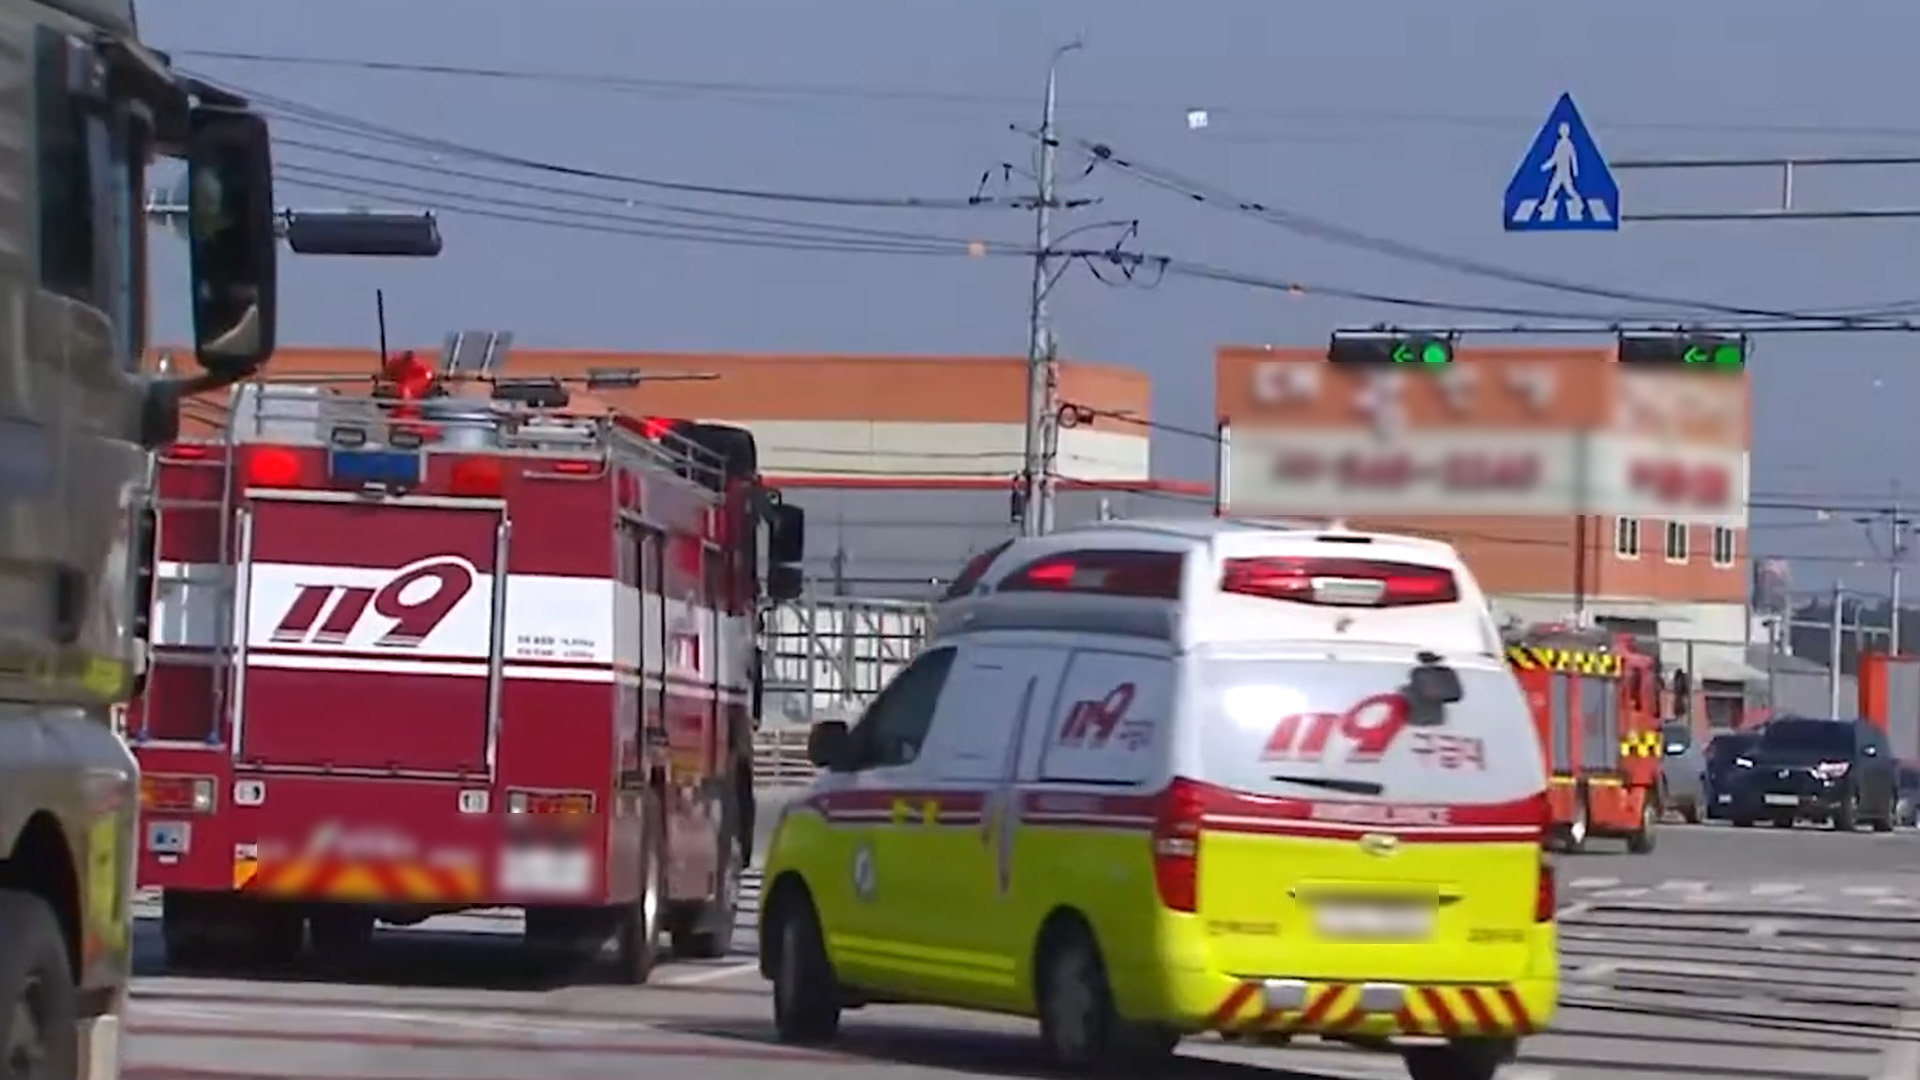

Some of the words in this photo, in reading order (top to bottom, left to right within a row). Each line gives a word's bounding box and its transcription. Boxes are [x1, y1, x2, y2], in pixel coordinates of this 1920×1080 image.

[269, 561, 473, 647] 119
[1058, 682, 1136, 749] 119
[1260, 692, 1410, 762] 119
